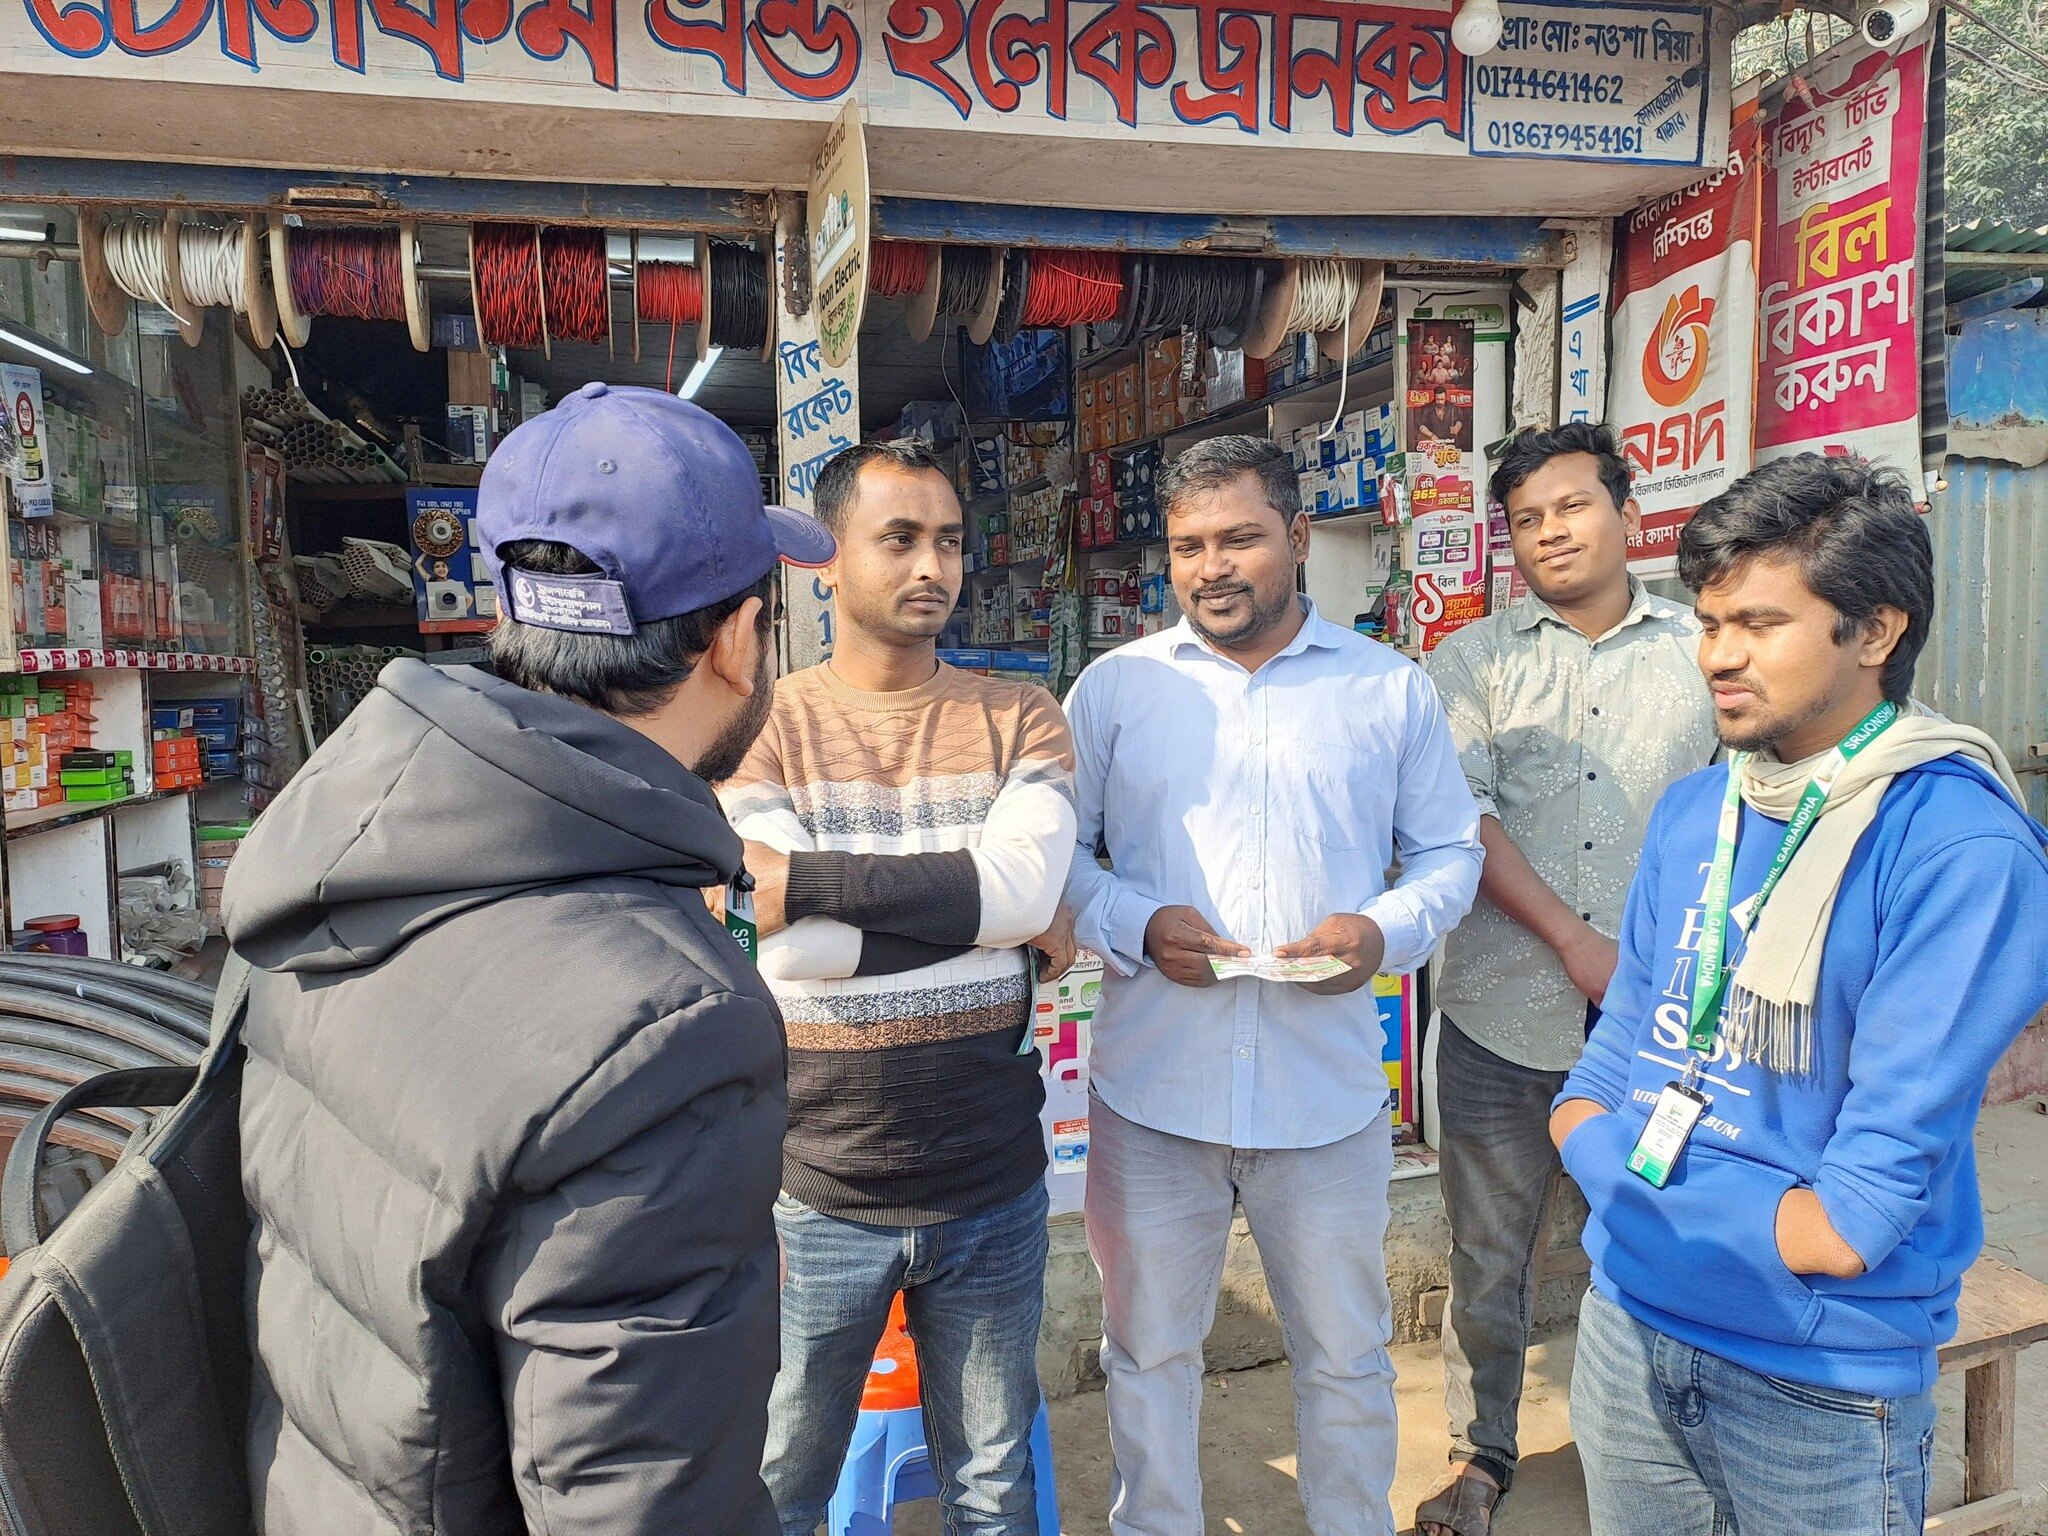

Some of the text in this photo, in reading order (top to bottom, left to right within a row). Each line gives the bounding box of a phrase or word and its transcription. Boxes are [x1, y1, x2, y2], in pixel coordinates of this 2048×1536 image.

[1542, 19, 1580, 53] মোঃ
[1477, 64, 1625, 105] 01744641462
[1487, 120, 1644, 154] 018679454161
[1777, 115, 1826, 157] বিদ্যুৎ
[1792, 136, 1874, 198] ইন্টারনেট
[1652, 207, 1714, 264] নিশ্চিন্তে
[1794, 197, 1892, 288] বিল
[834, 248, 861, 297] Electric
[1759, 258, 1916, 364] বিকাশ
[1774, 337, 1892, 413] করুন
[782, 377, 852, 440] রকেট
[1622, 398, 1726, 483] নগদ
[1412, 488, 1438, 501] 365
[1420, 477, 1434, 490] রবি
[1663, 473, 1698, 492] ডিজিটাল
[1698, 467, 1725, 486] লেনদেন
[1843, 704, 1895, 750] SRIJONSHIL
[1776, 796, 1819, 863] GAIBANDHA
[1701, 917, 1722, 988] GAIBANDHA
[1698, 1113, 1742, 1141] LBUM
